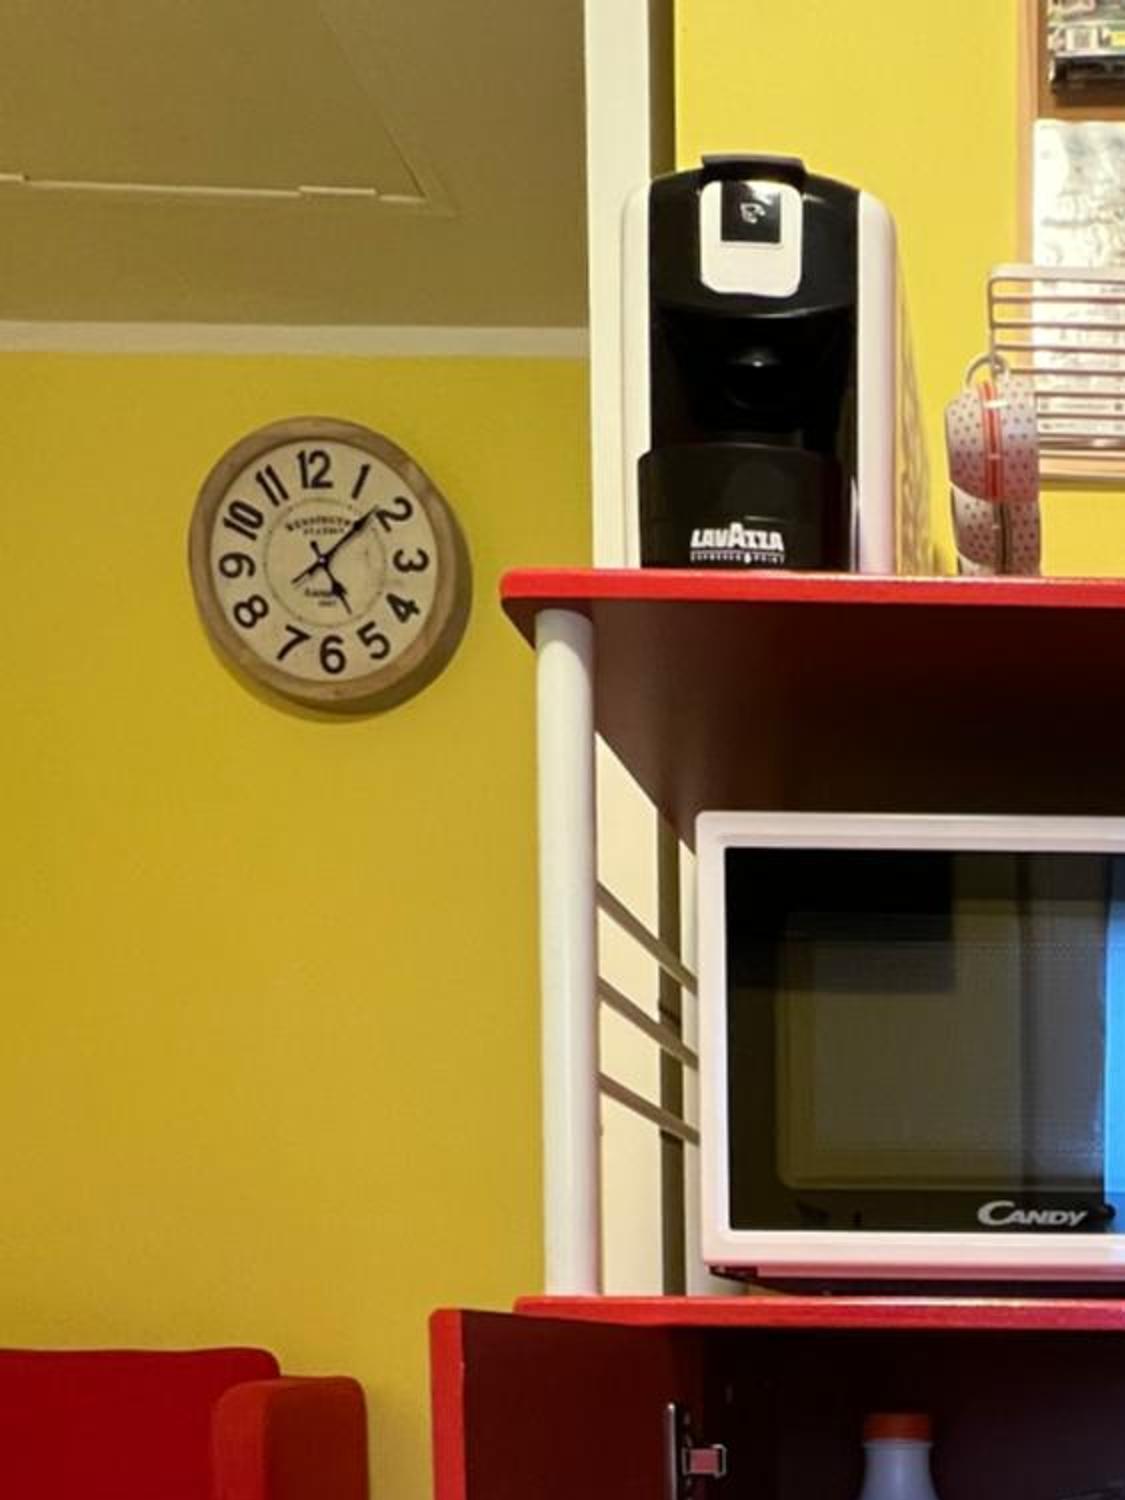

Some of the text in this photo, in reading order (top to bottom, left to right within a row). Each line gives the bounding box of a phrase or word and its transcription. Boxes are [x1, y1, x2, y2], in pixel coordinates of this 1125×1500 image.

[255, 464, 289, 508] 11
[297, 451, 333, 489] 12
[352, 464, 370, 499] 1
[223, 500, 263, 541] 10
[375, 496, 413, 533] 2
[690, 522, 784, 551] LAVAZZA
[219, 552, 255, 579] 9
[393, 548, 429, 573] 3
[233, 595, 269, 629] 8
[386, 593, 420, 623] 4
[277, 624, 311, 661] 7
[320, 635, 346, 674] 6
[356, 621, 391, 660] 5
